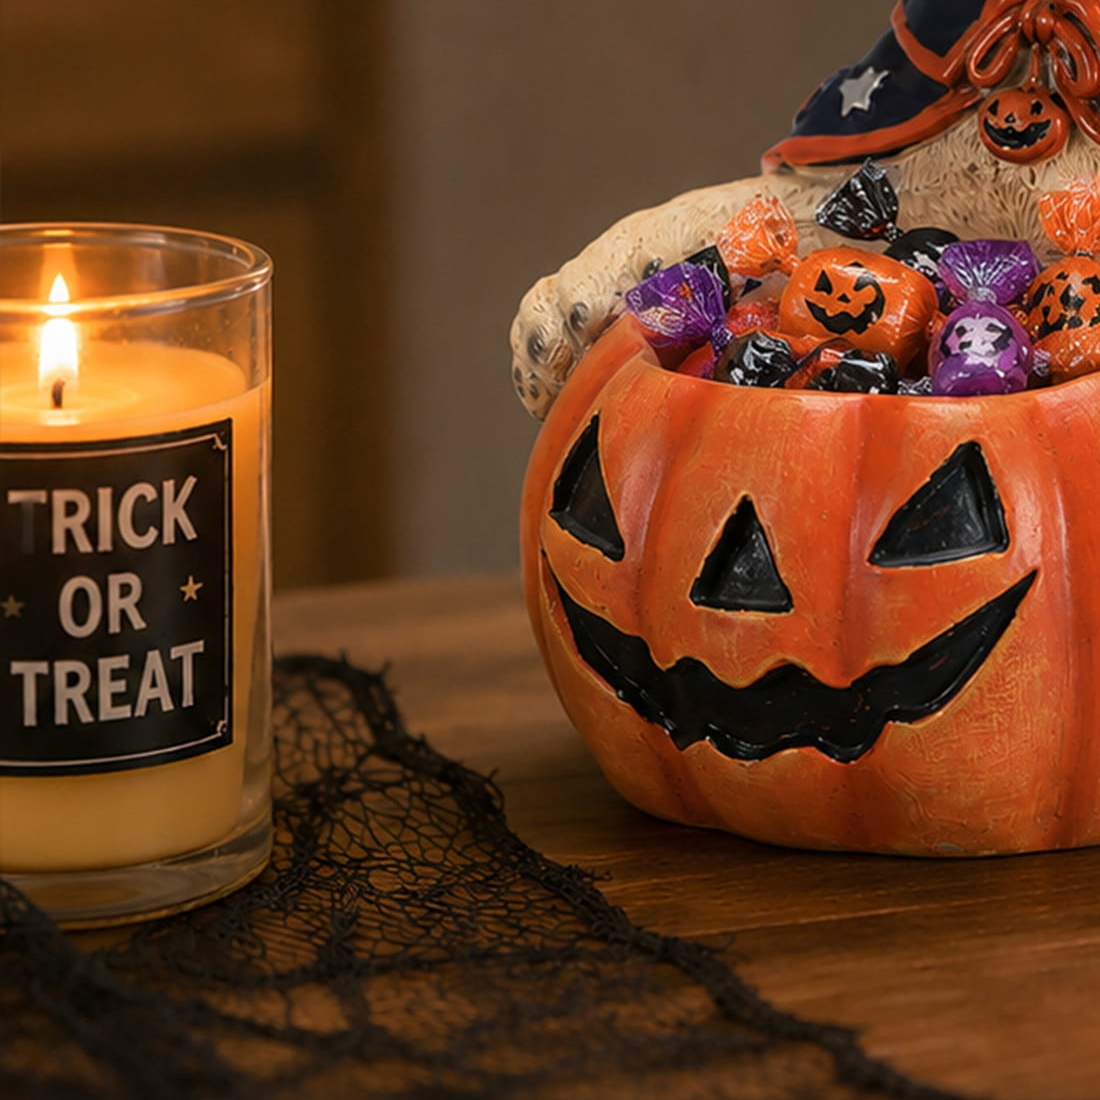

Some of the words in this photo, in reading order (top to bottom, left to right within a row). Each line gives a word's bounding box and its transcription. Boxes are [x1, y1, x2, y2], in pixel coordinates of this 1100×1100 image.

[8, 475, 198, 554] TRICK
[58, 572, 147, 638] OR
[10, 640, 205, 726] TREAT
